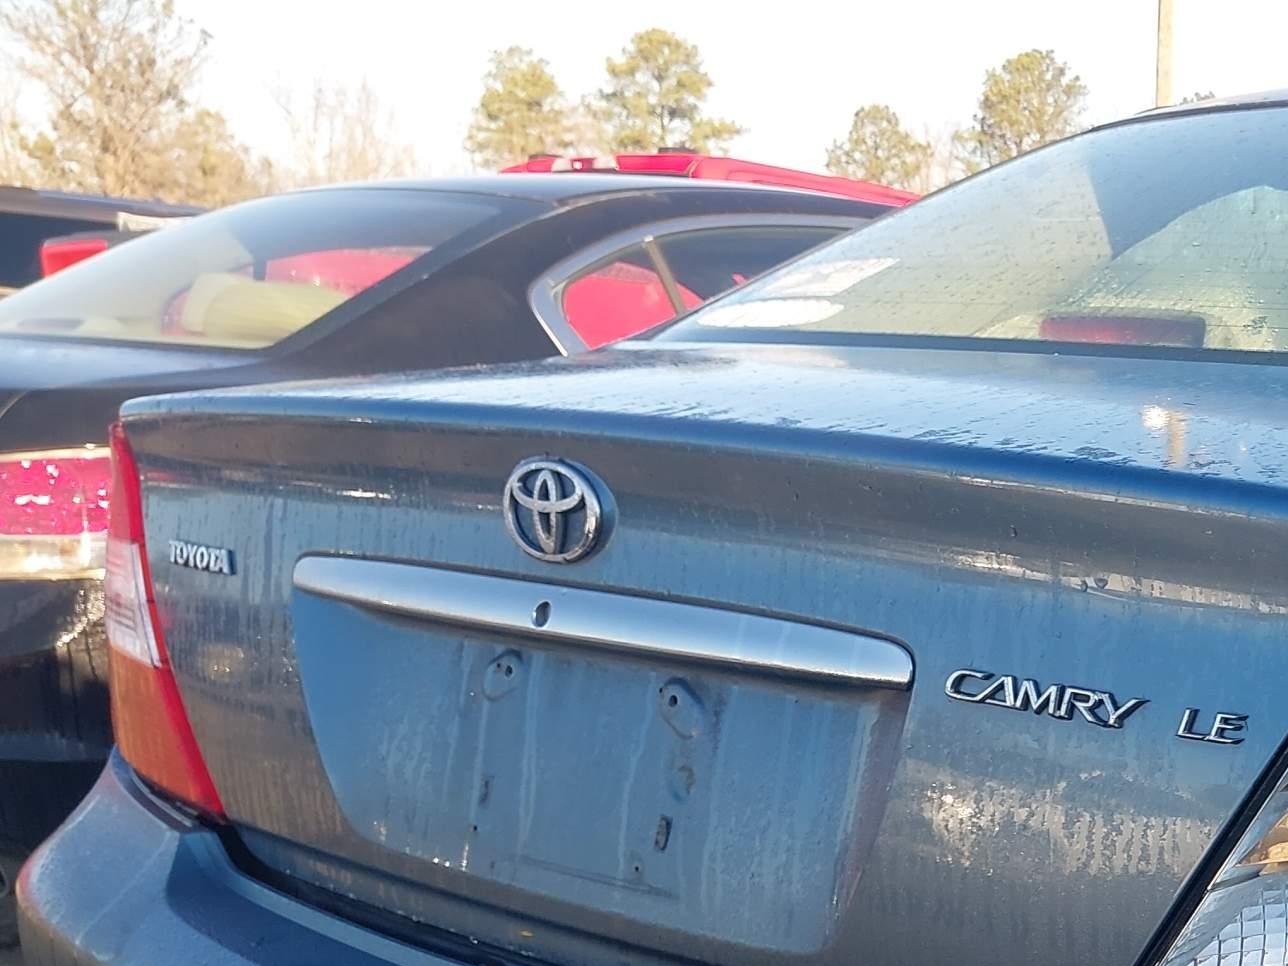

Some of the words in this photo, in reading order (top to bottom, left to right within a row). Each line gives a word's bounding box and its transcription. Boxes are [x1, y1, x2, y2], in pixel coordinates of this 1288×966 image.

[168, 539, 231, 575] TOYOTA
[944, 668, 1151, 728] CAMRY
[1175, 706, 1249, 745] LE
